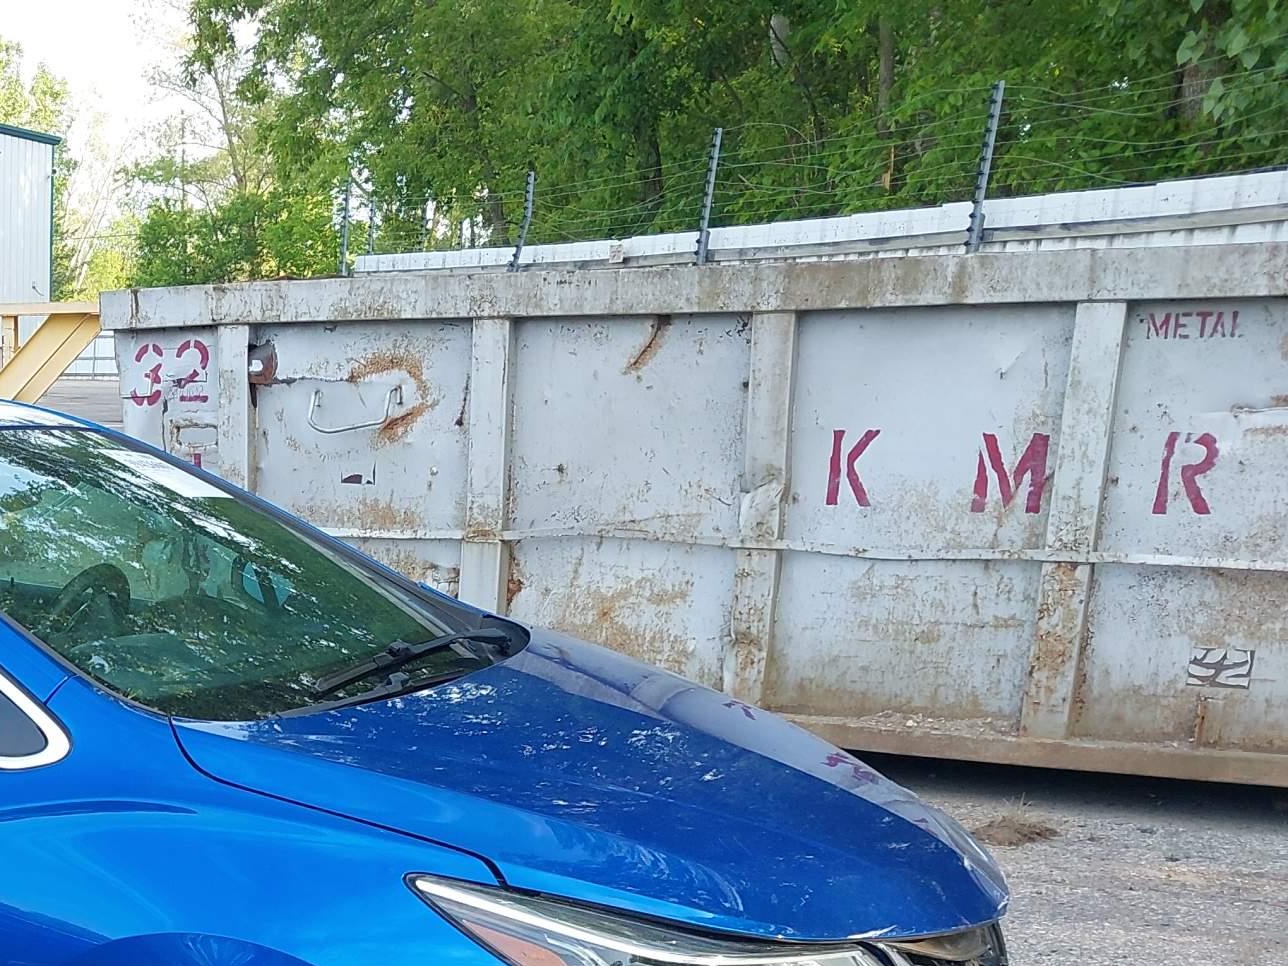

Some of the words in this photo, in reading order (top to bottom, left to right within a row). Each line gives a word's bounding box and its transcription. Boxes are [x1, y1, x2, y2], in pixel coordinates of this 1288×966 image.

[1146, 310, 1244, 340] METAL
[132, 340, 209, 407] 32
[825, 429, 881, 506] K
[970, 432, 1050, 513] M
[1151, 432, 1221, 514] R
